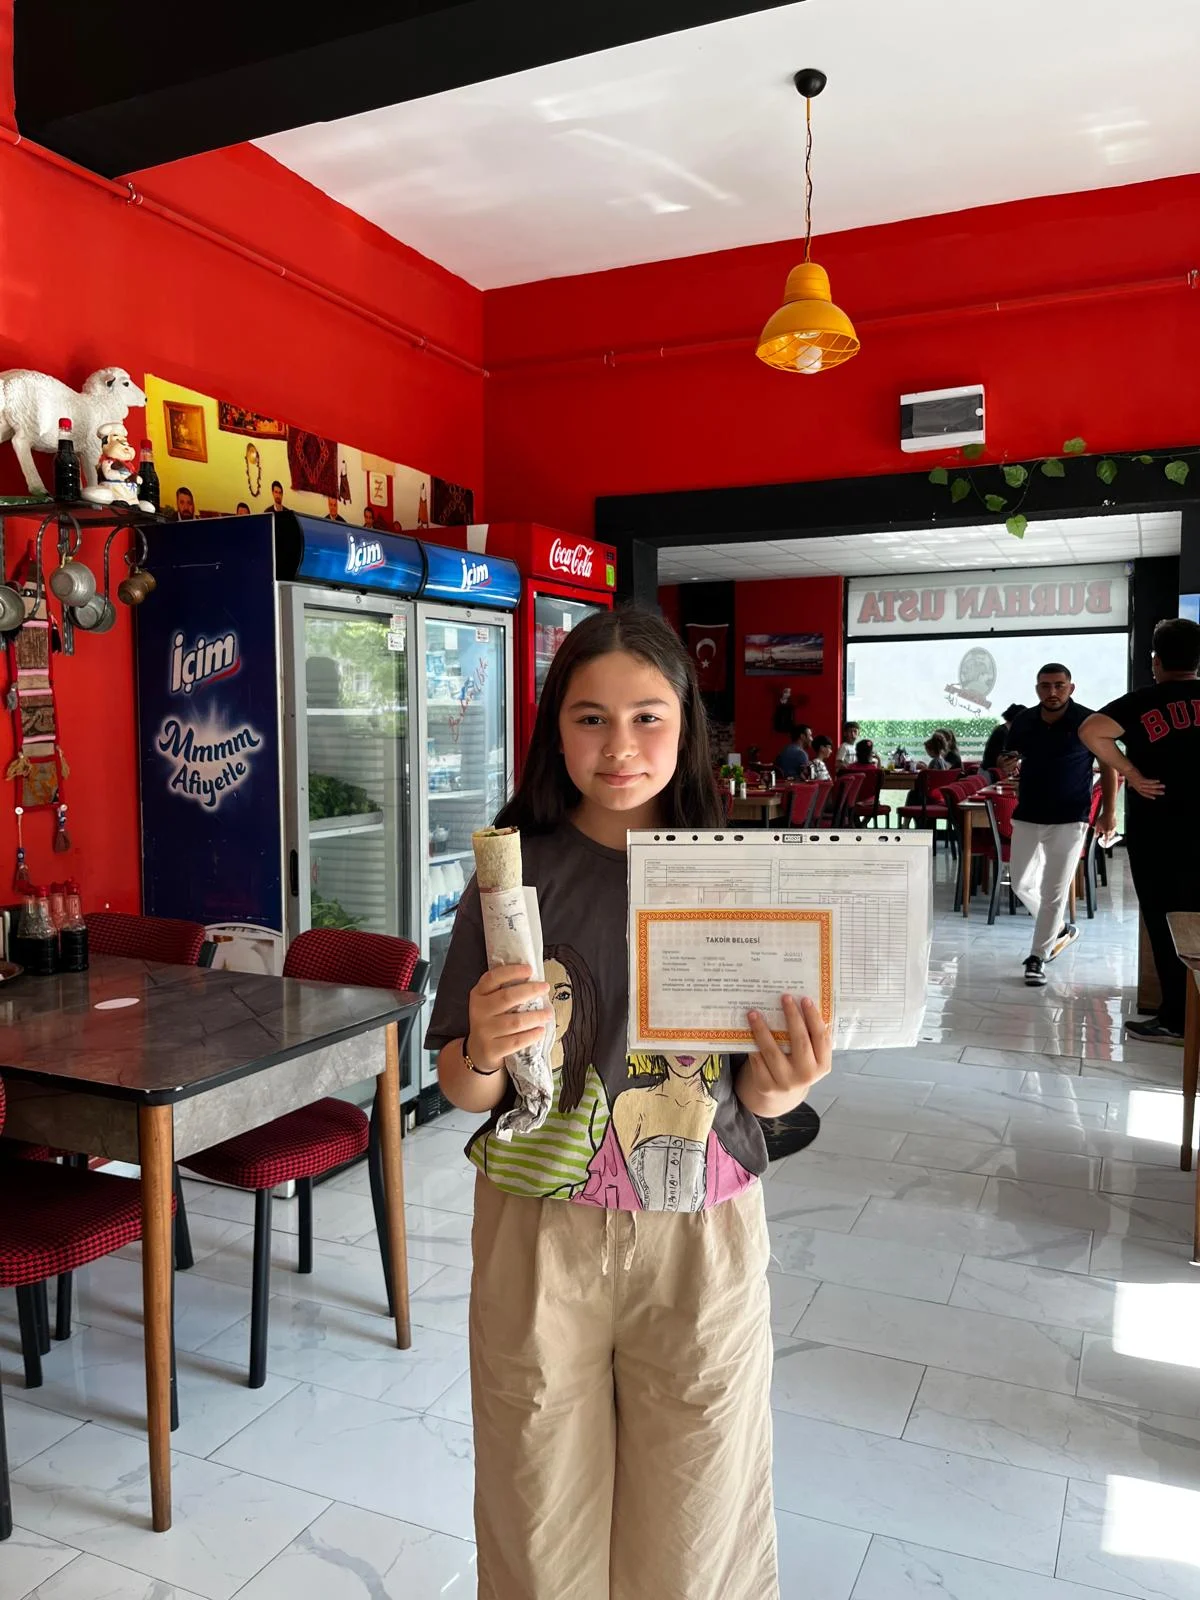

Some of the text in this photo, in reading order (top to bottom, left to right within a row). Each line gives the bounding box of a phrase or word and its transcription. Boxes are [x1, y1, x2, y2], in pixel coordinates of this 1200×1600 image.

[346, 535, 383, 573] İçim
[171, 632, 235, 693] İçim
[158, 720, 260, 764] Mmmm
[171, 761, 247, 807] Afiyetle
[705, 935, 760, 944] TAKDİR BELGESİ
